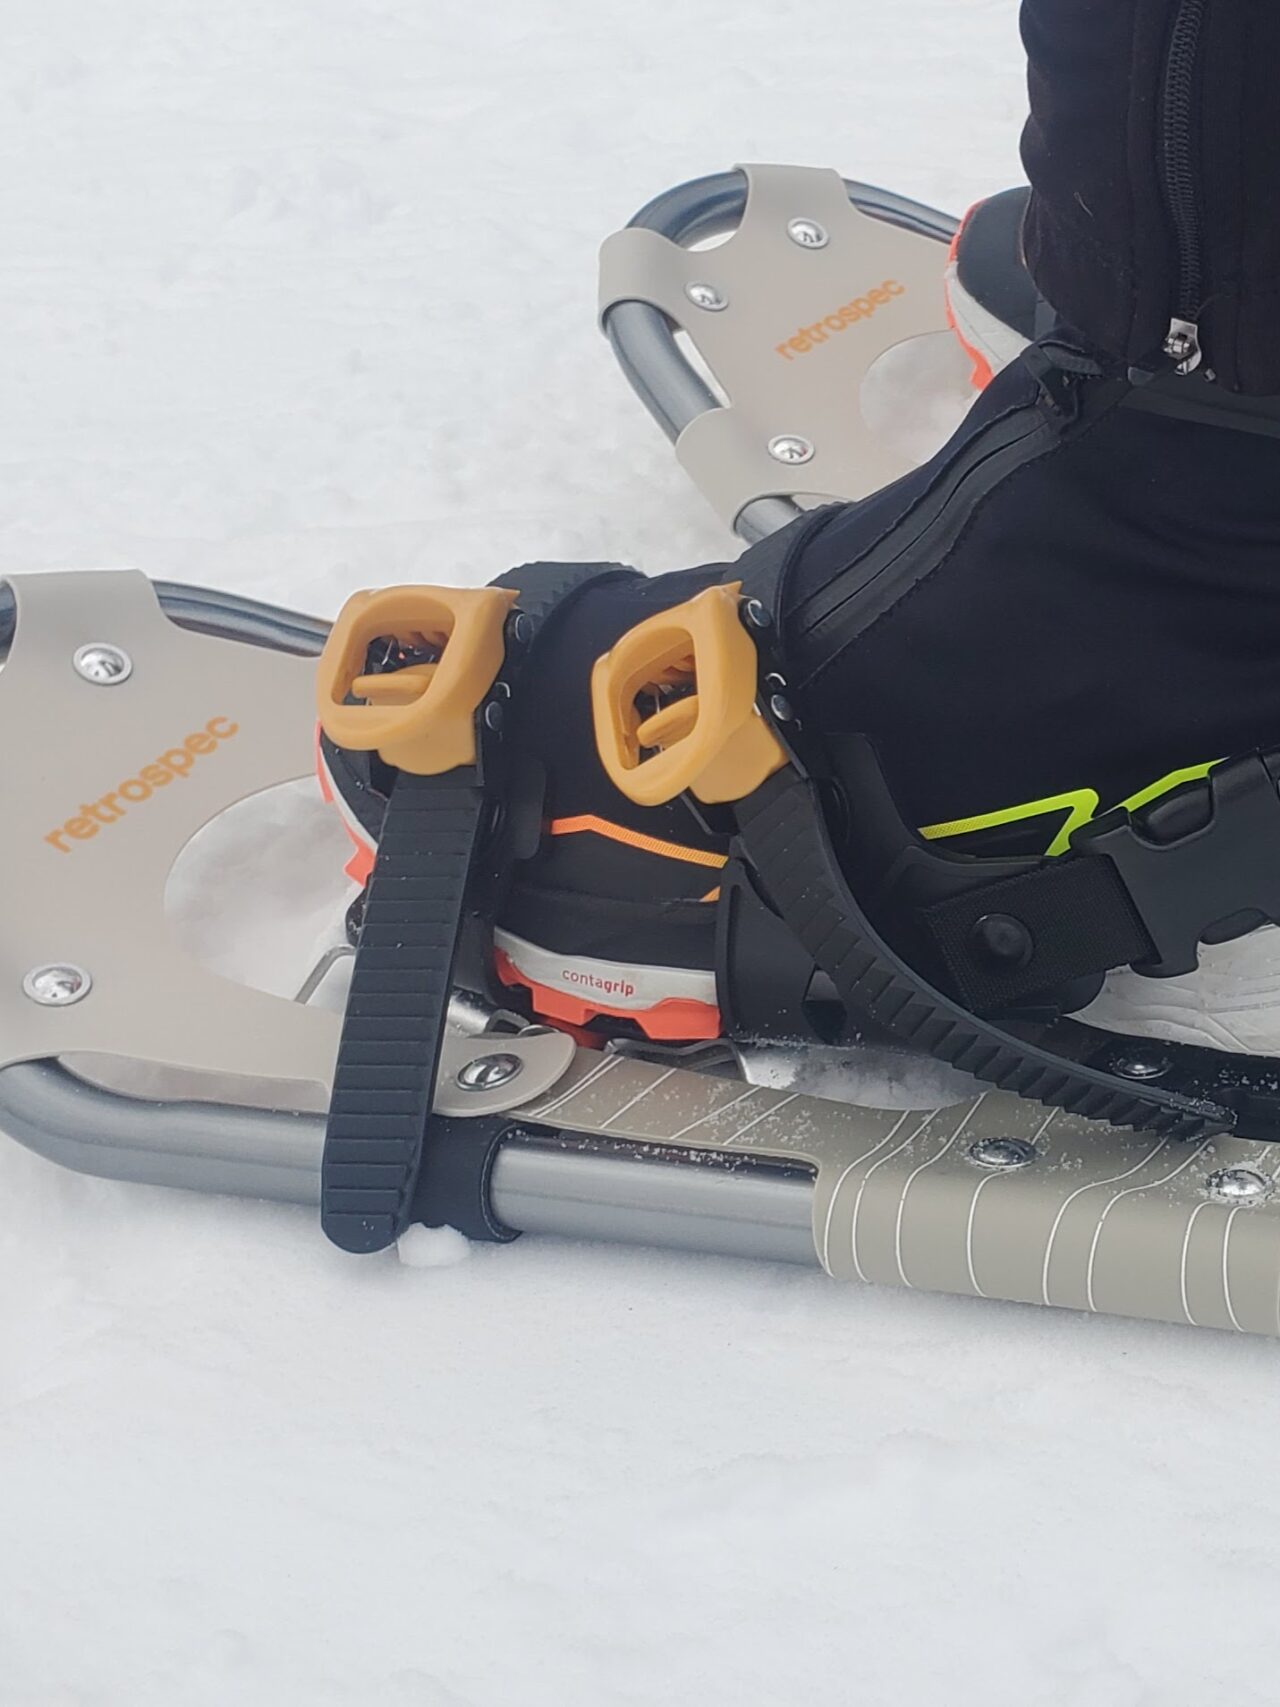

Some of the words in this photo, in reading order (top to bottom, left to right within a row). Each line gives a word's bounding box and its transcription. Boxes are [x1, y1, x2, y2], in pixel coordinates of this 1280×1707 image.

[775, 280, 905, 361] retrospec
[45, 717, 239, 853] retrospec
[562, 969, 634, 997] contagrip
